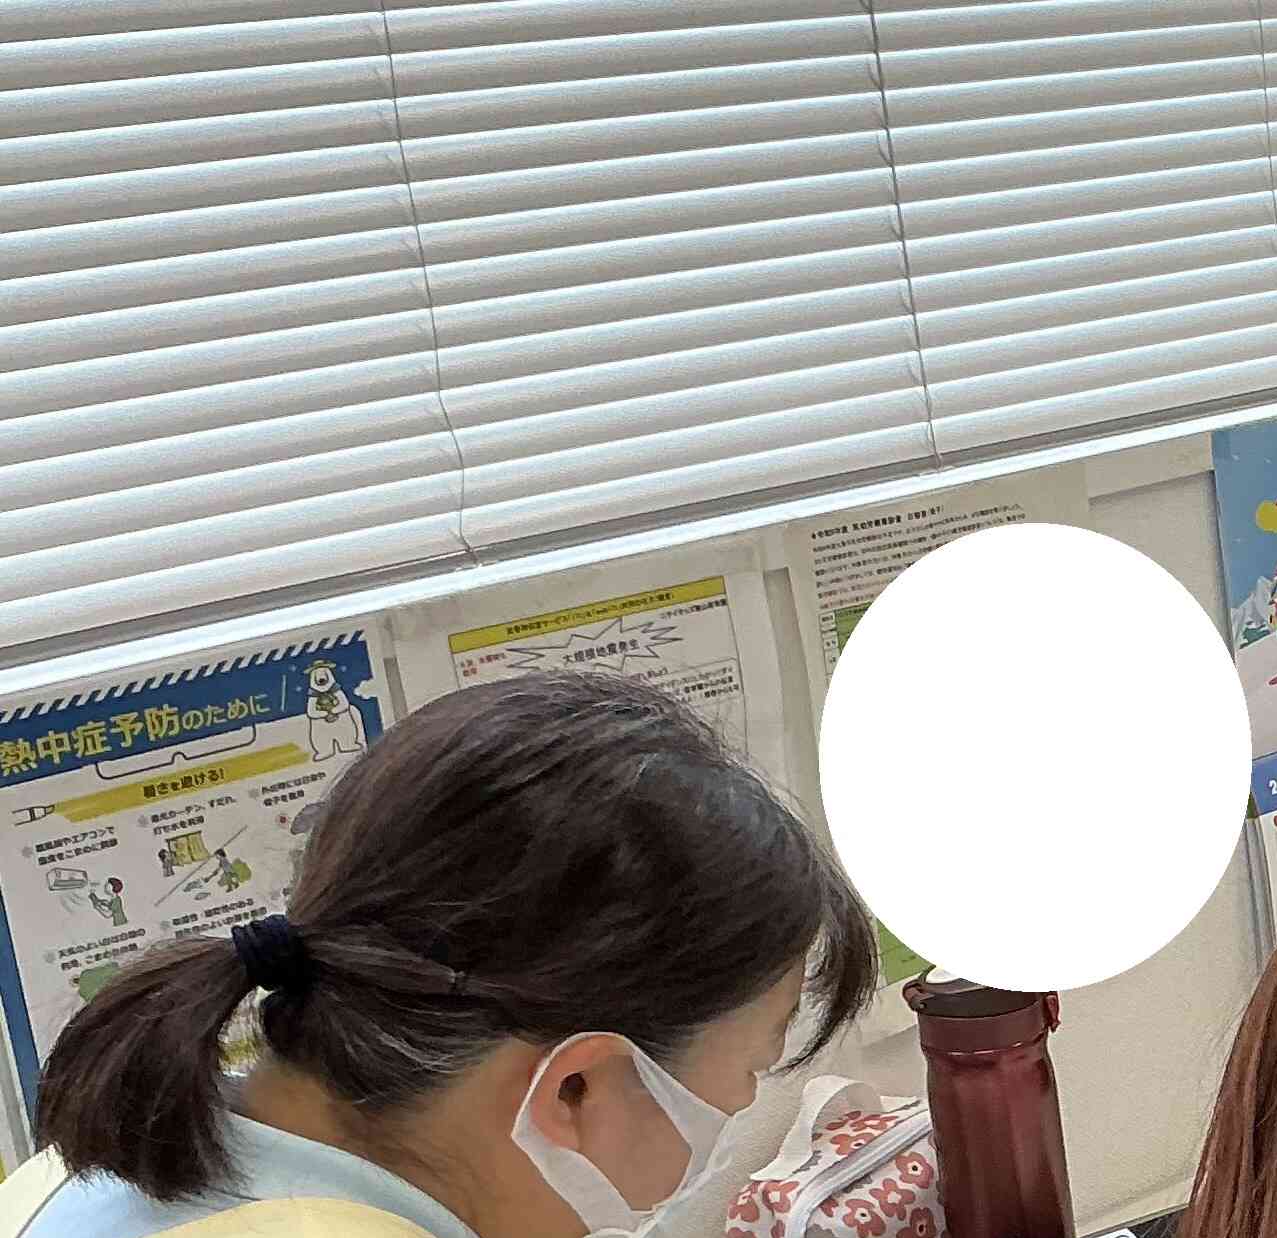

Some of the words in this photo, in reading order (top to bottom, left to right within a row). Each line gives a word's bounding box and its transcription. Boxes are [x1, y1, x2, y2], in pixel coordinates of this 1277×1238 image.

[562, 638, 641, 664] 大規模地震発生
[0, 701, 271, 775] 熱中症予防のために
